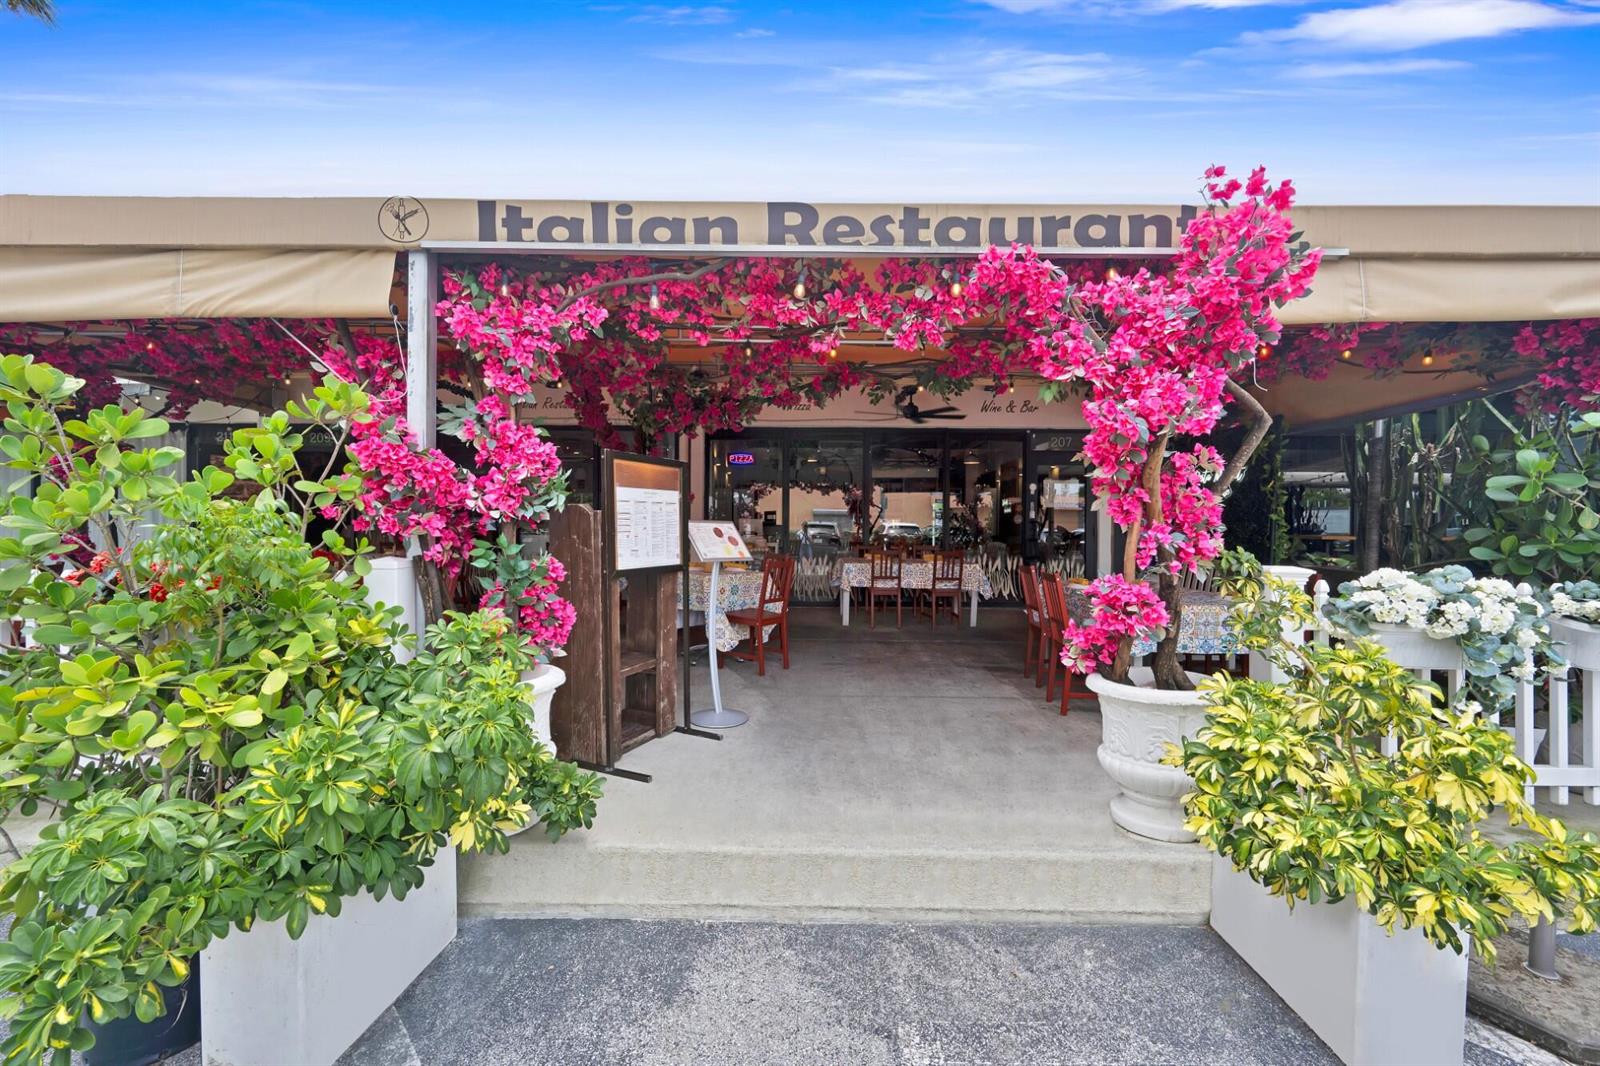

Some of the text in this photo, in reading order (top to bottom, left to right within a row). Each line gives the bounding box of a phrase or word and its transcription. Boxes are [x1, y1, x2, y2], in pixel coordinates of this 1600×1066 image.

[478, 200, 738, 245] Italian
[980, 400, 1040, 413] Wine & Bar
[1050, 437, 1072, 448] 207
[729, 453, 754, 464] PIZZA
